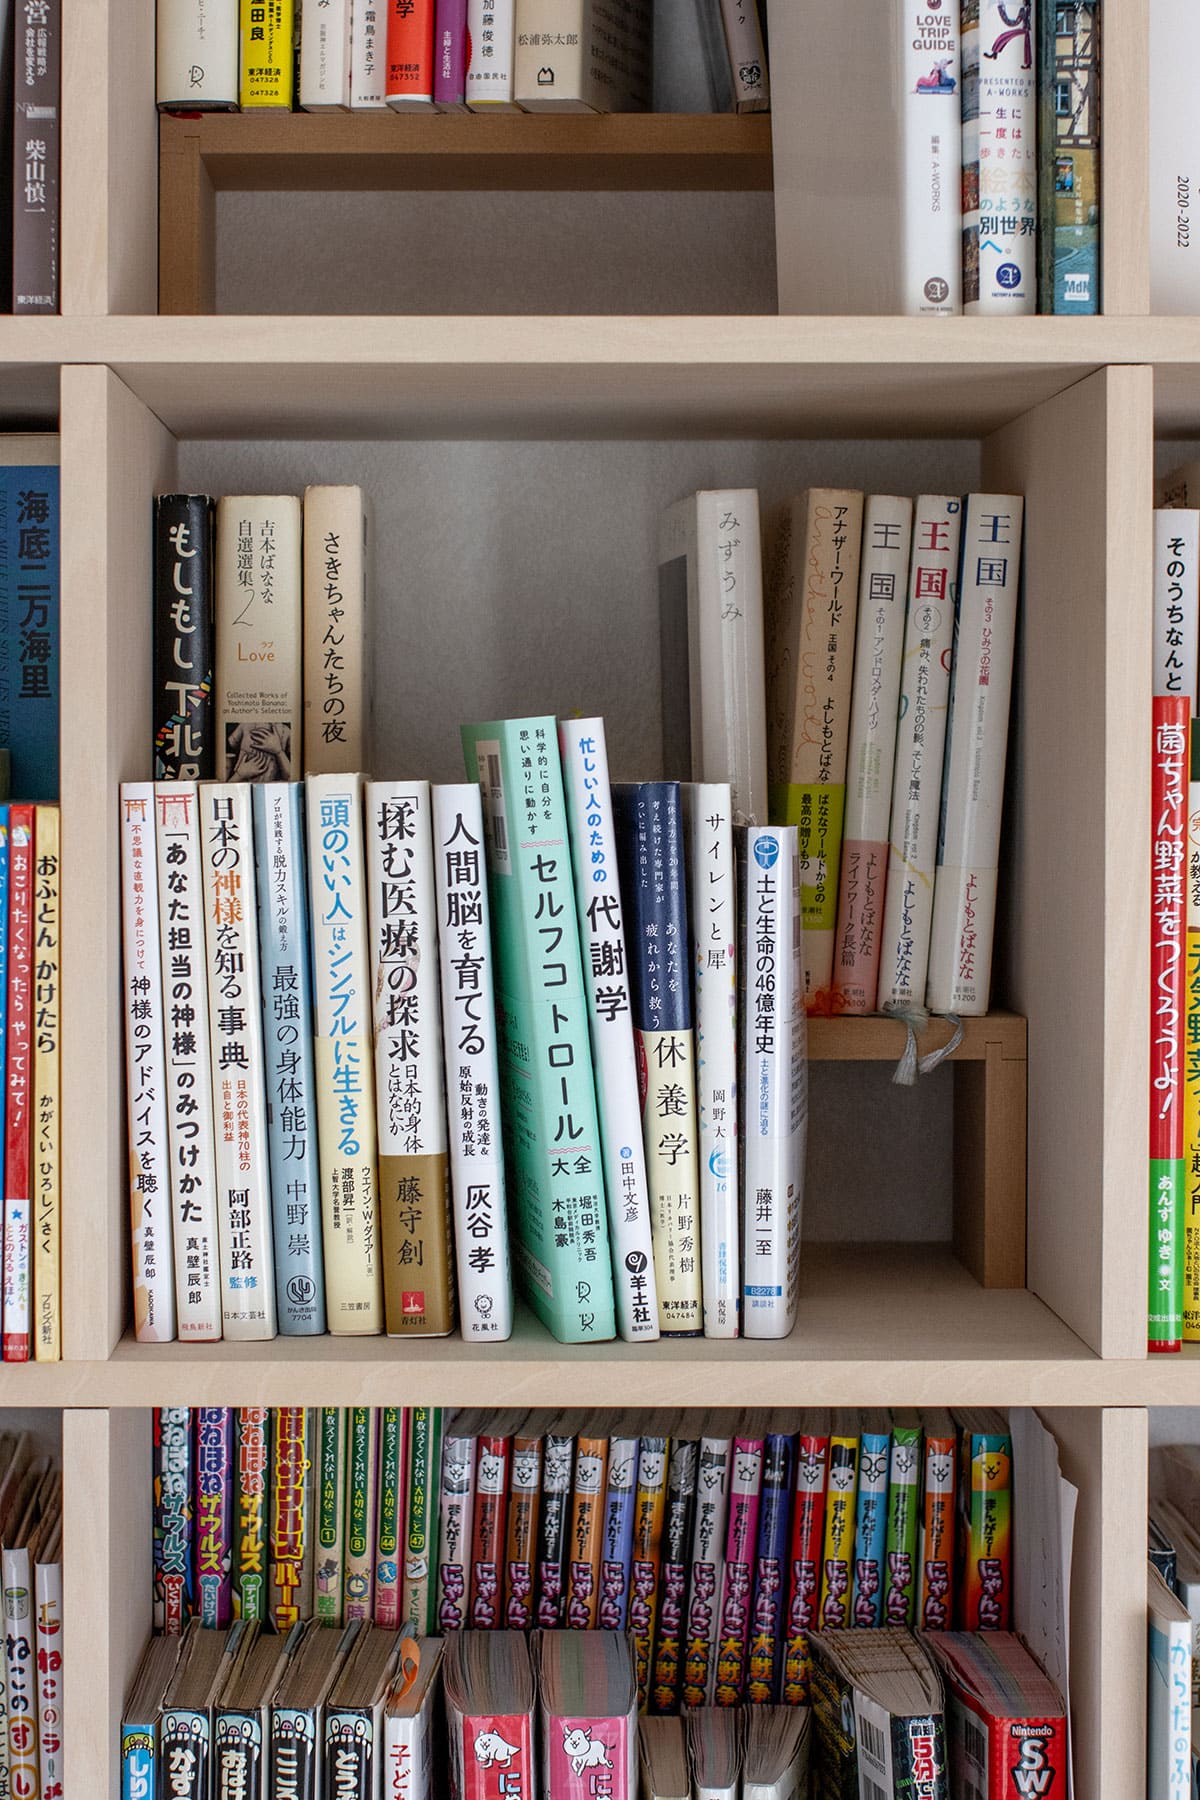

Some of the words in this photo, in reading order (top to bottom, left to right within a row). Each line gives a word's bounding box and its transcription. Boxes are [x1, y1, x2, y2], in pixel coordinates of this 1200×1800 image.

[518, 33, 579, 46] 松浦弥太郎
[912, 39, 956, 51] GUIDE
[916, 15, 952, 27] LOVE
[918, 27, 950, 38] TRIP
[248, 68, 281, 77] 東洋経済
[391, 64, 420, 72] 東洋経済
[986, 89, 1029, 97] A-WORKS
[980, 107, 1022, 119] 一生に
[980, 127, 1022, 139] 一度は
[25, 139, 46, 212] 柴山慎一
[980, 197, 1035, 212] のような
[1177, 175, 1190, 248] 2020-2022
[979, 216, 1037, 236] 別世界
[259, 519, 276, 605] 吉本ばなな
[719, 511, 743, 626] みずうみ
[826, 505, 849, 629] アナザー・ワールド
[869, 523, 902, 602] 王国
[915, 521, 950, 601] 王国
[975, 514, 1011, 588] 王国
[17, 490, 52, 698] 海底二万海里
[1164, 536, 1187, 693] そのうちなんと
[237, 641, 275, 662] Love
[321, 531, 348, 744] さきちゃんたちの夜
[977, 627, 994, 687] ひみつの花園
[226, 691, 257, 699] Collected
[259, 691, 279, 699] Works
[519, 730, 539, 836] 思い通りに動かす
[534, 728, 552, 821] 科学的に自分を
[579, 736, 607, 883] 忙しい人のための
[637, 801, 649, 888] ついに編み出した
[652, 799, 667, 905] 考え続けた専門家が
[799, 793, 814, 872] 最高の贈りもの
[814, 793, 831, 904] ばななワールドからの
[36, 854, 58, 949] おふとん
[273, 796, 290, 952] プロが実践する脱力スキルの鍛え方
[704, 812, 728, 971] サイレンと犀
[840, 852, 859, 968] ライフワーク長篇
[859, 851, 879, 957] よしもとばなな
[208, 797, 250, 1071] 日本の神様を知る事典
[377, 795, 422, 1062] 「揉む医療」の探求
[442, 812, 486, 1056] 人間脳を育てる
[586, 894, 629, 1022] 代謝学
[665, 922, 681, 994] あなたを
[895, 880, 915, 987] よしもとばなな
[960, 872, 980, 981] よしもとばなな
[1152, 721, 1187, 1121] 菌ちゃん野菜をつくろうよ!
[319, 792, 363, 1157] 「頭のいい人」はシンプルに生きる
[529, 853, 584, 1144] セルフコントロール
[645, 922, 664, 1029] 疲れから救う
[754, 873, 777, 1055] 土と生命の46億年史
[36, 959, 58, 1055] かけたら
[164, 832, 203, 1224] 「あなた担当の神様」のみつけかた
[130, 975, 160, 1219] 神様のアドバイスを聴く
[271, 964, 308, 1161] 最強の身体能力
[388, 1063, 406, 1137] とはなにか
[652, 1034, 690, 1166] 休養学
[39, 1094, 54, 1153] かがくい
[222, 1079, 235, 1142] 出自と御利益
[237, 1079, 252, 1172] 日本の代表神70柱の
[403, 1063, 426, 1154] 日本的身体
[458, 1065, 476, 1157] 原始反射の成長
[551, 1154, 592, 1178] 大全
[620, 1161, 639, 1224] 田中文彦
[715, 1182, 728, 1193] 16
[143, 1226, 157, 1279] 真壁辰郎
[228, 1188, 255, 1271] 阿部正路
[286, 1178, 311, 1257] 中野崇
[396, 1176, 425, 1267] 藤守創
[465, 1183, 496, 1274] 灰谷孝
[551, 1198, 570, 1248] 木島豪
[579, 1195, 597, 1262] 堀田秀吾
[677, 1193, 696, 1274] 片野秀樹
[755, 1188, 773, 1257] 藤井一至
[186, 1237, 202, 1305] 真壁辰郎
[228, 1276, 259, 1290] 監修
[340, 1301, 371, 1312] 三笠書房
[629, 1274, 651, 1323] 羊土社
[661, 1300, 699, 1311] 東洋経済
[223, 1310, 267, 1321] 日本文芸社
[291, 1314, 313, 1322] 7704
[401, 1315, 427, 1326] 青灯社
[471, 1322, 499, 1332] 花風社
[665, 1311, 696, 1319] 047484
[198, 1408, 227, 1573] ほねほねザウルス
[239, 1408, 268, 1573] ほねほねザウルス
[683, 1560, 717, 1708] にゃんこ大戦争
[714, 1560, 752, 1707] にゃんこ大戦争
[170, 1747, 197, 1796] かず
[1012, 1726, 1053, 1738] Nintendo
